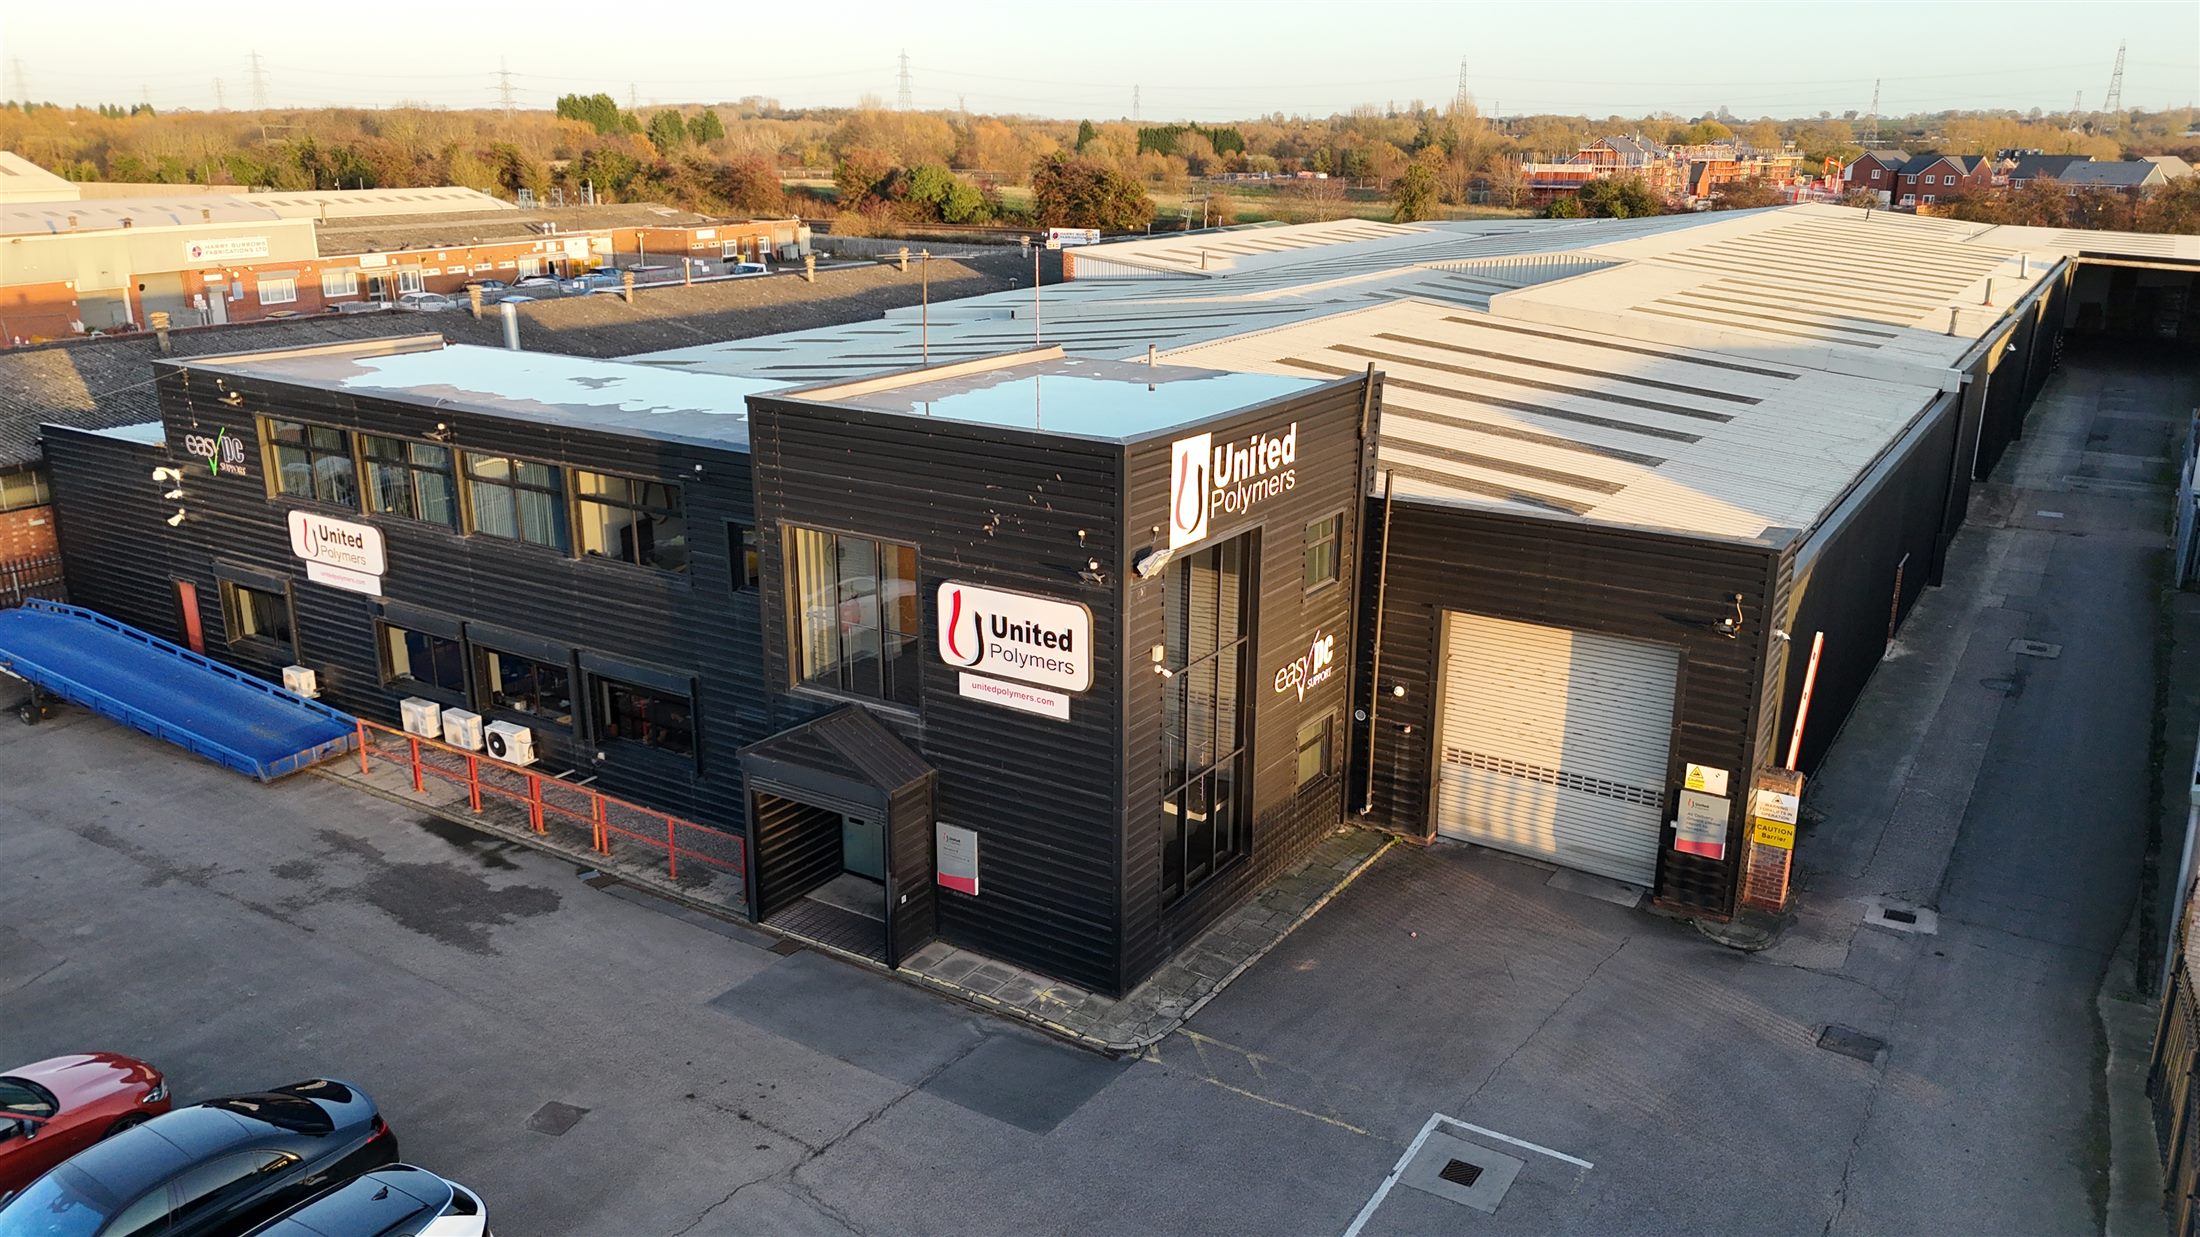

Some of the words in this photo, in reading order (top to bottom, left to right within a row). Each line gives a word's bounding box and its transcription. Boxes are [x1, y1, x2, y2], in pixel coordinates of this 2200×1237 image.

[1214, 421, 1297, 488] United
[1210, 468, 1296, 519] Polymers
[319, 524, 363, 549] United
[320, 545, 367, 566] Polymers
[991, 613, 1073, 653] United
[990, 643, 1075, 675] Polymers
[1306, 666, 1333, 690] SUPPORT
[971, 681, 1055, 707] unitedpolymers.com
[1757, 824, 1793, 836] CAUTION
[1761, 832, 1787, 842] Barrier
